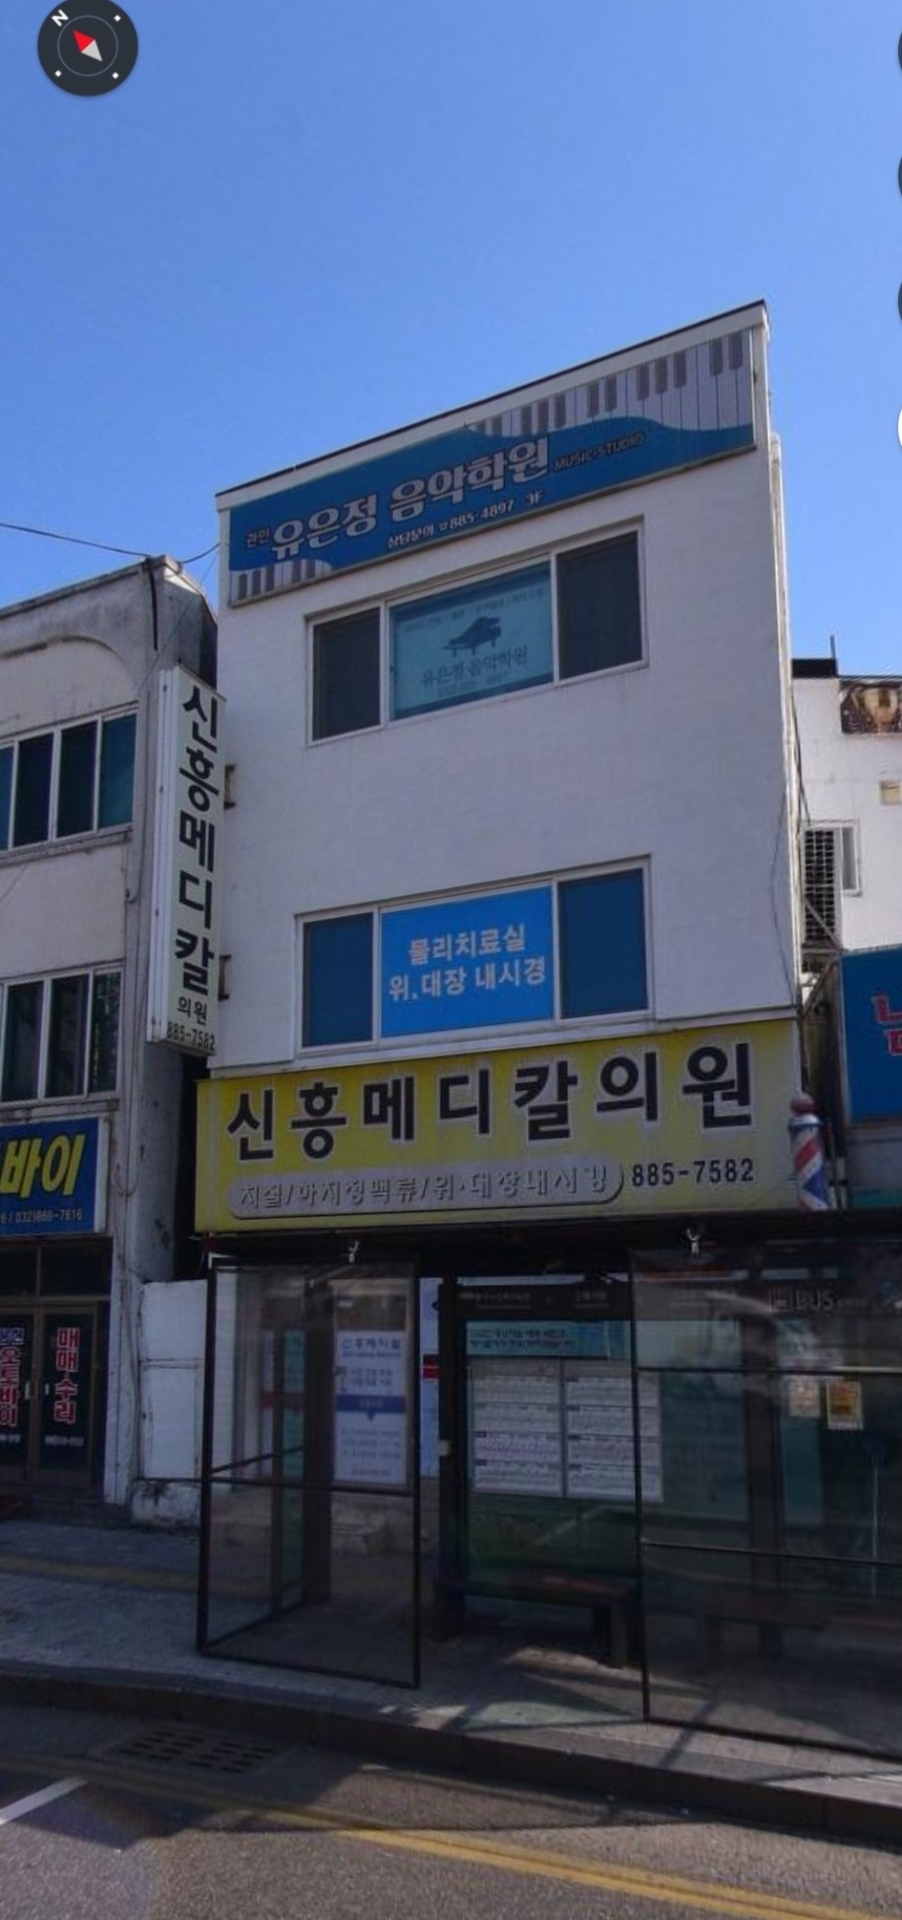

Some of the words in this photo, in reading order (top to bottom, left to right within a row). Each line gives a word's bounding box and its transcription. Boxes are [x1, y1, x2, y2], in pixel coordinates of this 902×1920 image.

[272, 492, 378, 560] 유은정
[389, 437, 549, 523] 음악학원
[525, 490, 544, 507] 3F
[175, 686, 220, 996] 신흥메디칼
[409, 924, 526, 966] 물리치료실
[475, 956, 546, 990] 내시경
[177, 996, 208, 1026] 의원
[166, 1021, 215, 1052] 885-7582
[227, 1042, 753, 1160] 신흥메디칼의원
[631, 1158, 754, 1187] 885-7582
